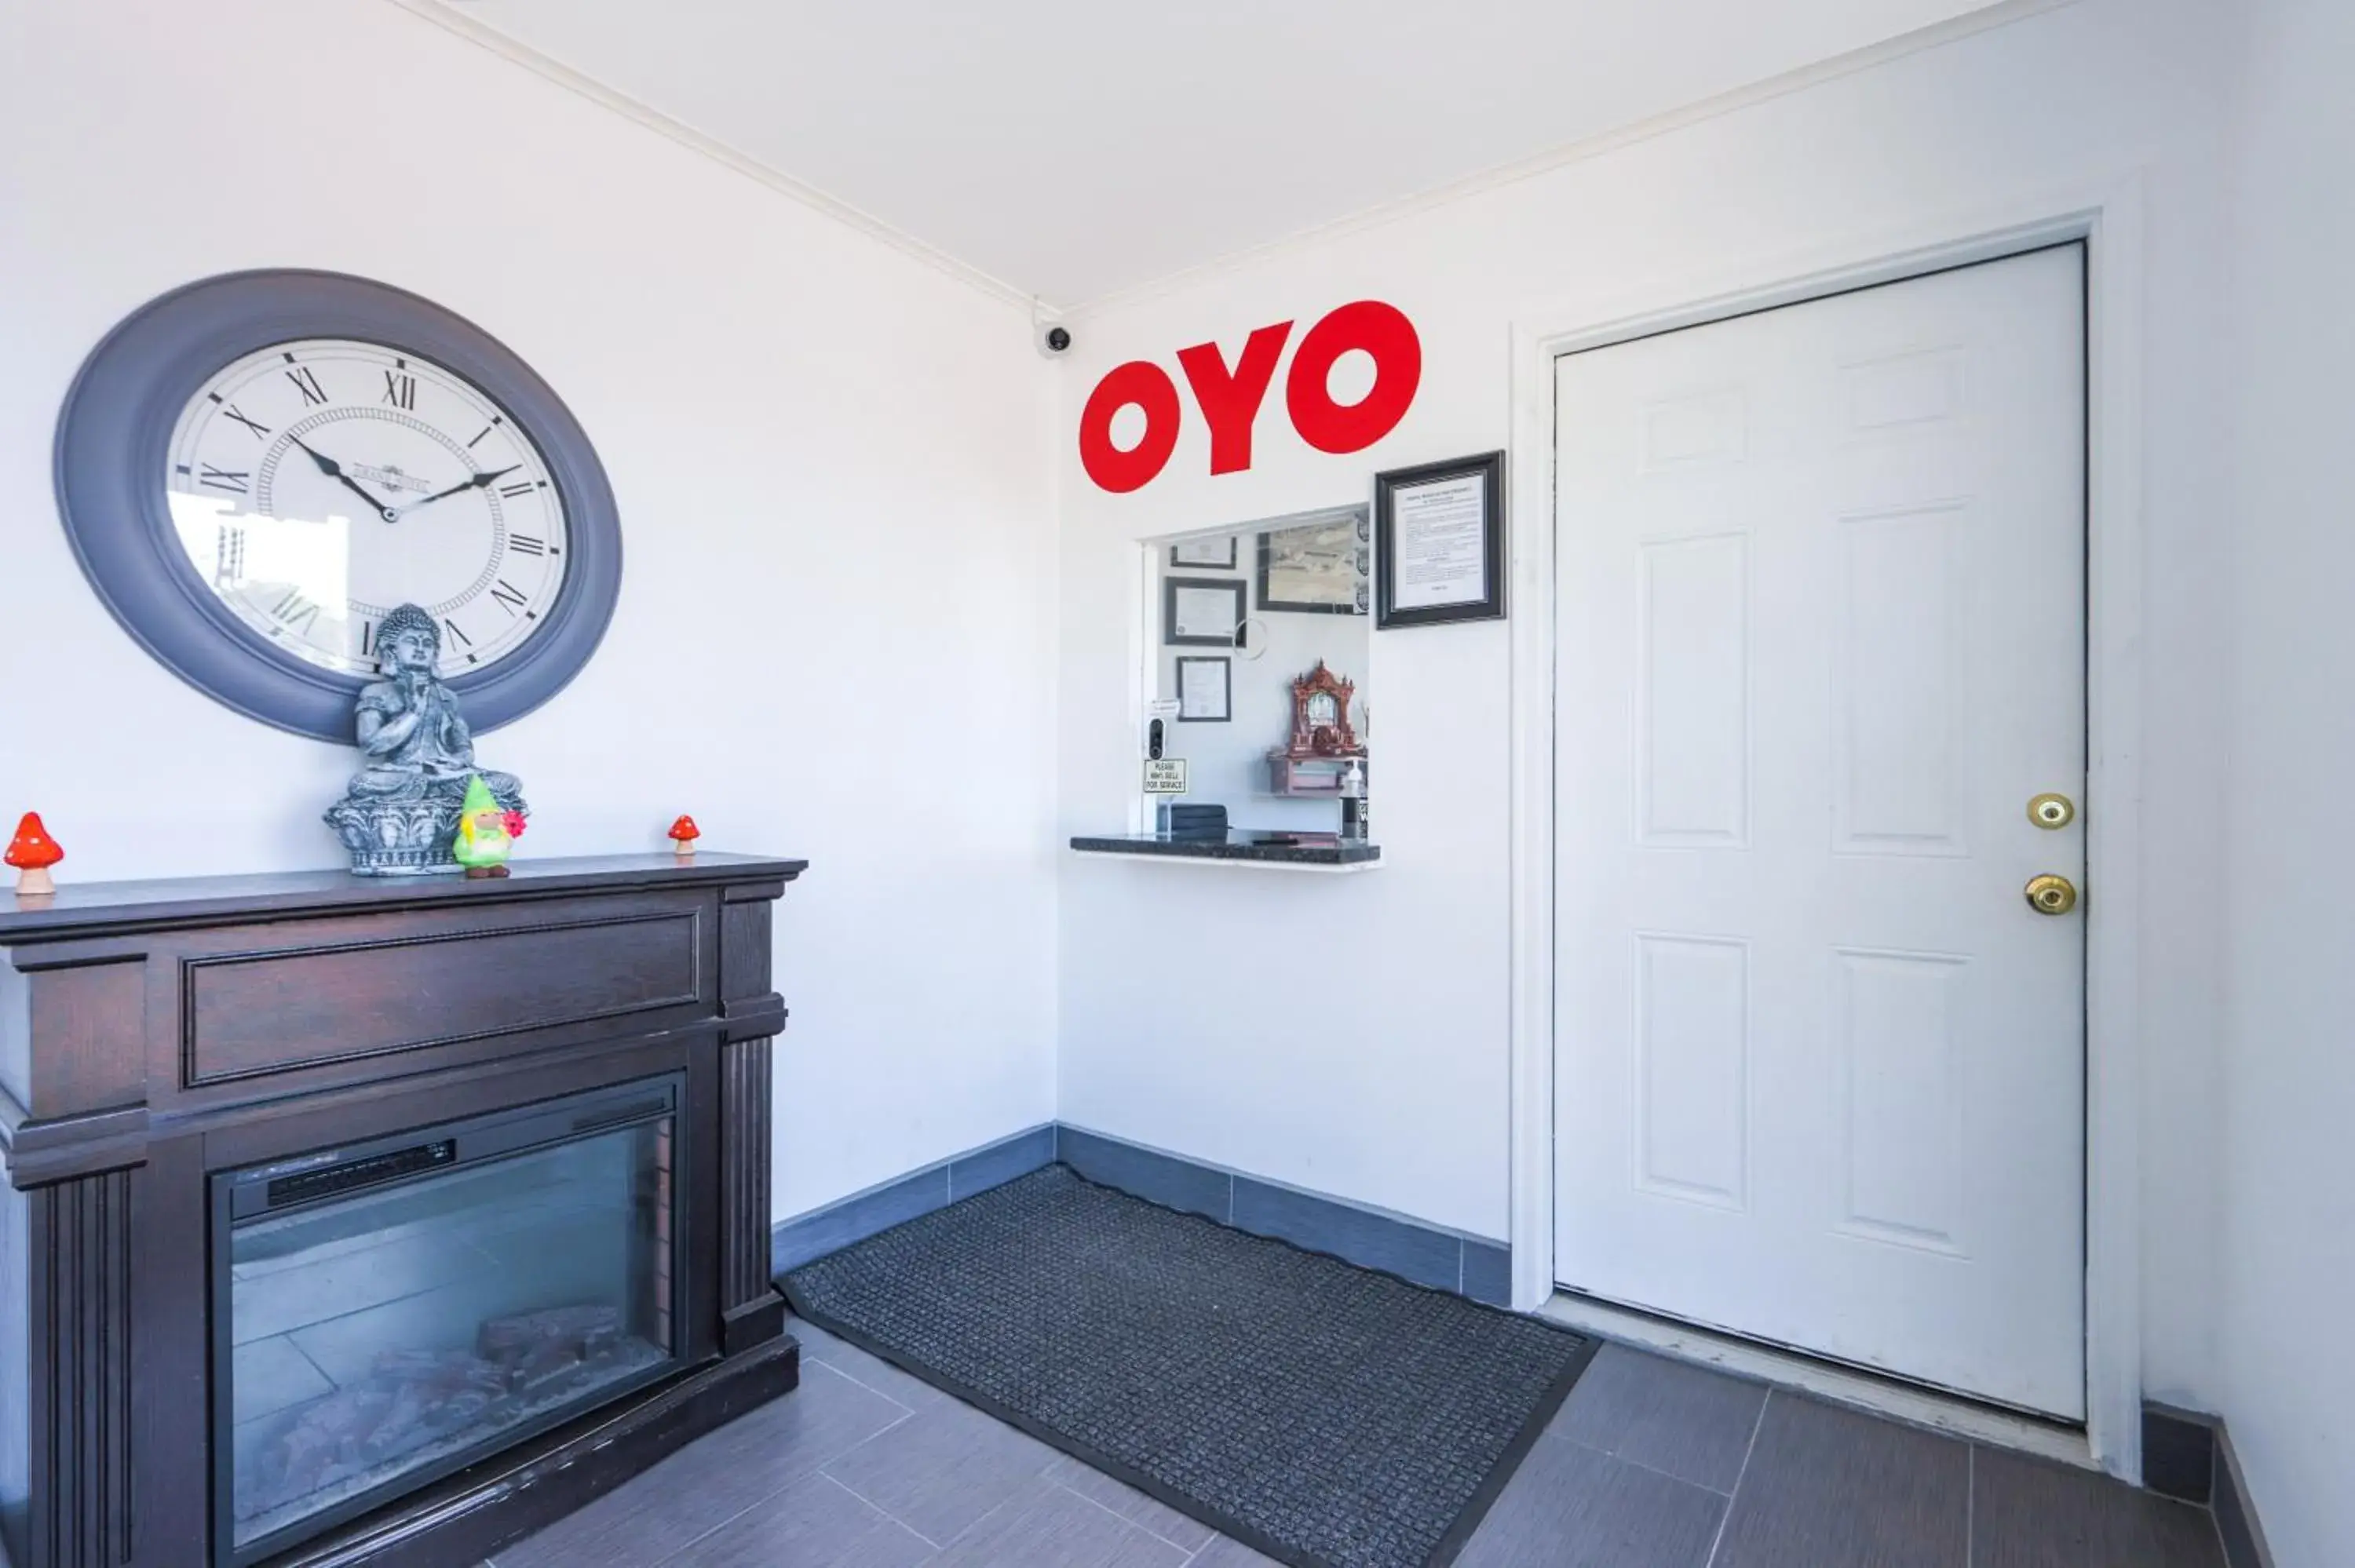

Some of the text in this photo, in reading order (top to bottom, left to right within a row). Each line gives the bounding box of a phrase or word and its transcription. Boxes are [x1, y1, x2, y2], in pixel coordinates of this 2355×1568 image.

[286, 366, 328, 407] XI
[382, 370, 415, 410] XII
[1079, 300, 1422, 494] OYO
[224, 403, 272, 439] X
[467, 426, 491, 448] I
[200, 462, 249, 493] IX
[500, 482, 534, 499] II
[509, 533, 544, 556] III
[491, 579, 528, 618] IV
[444, 618, 472, 653] V
